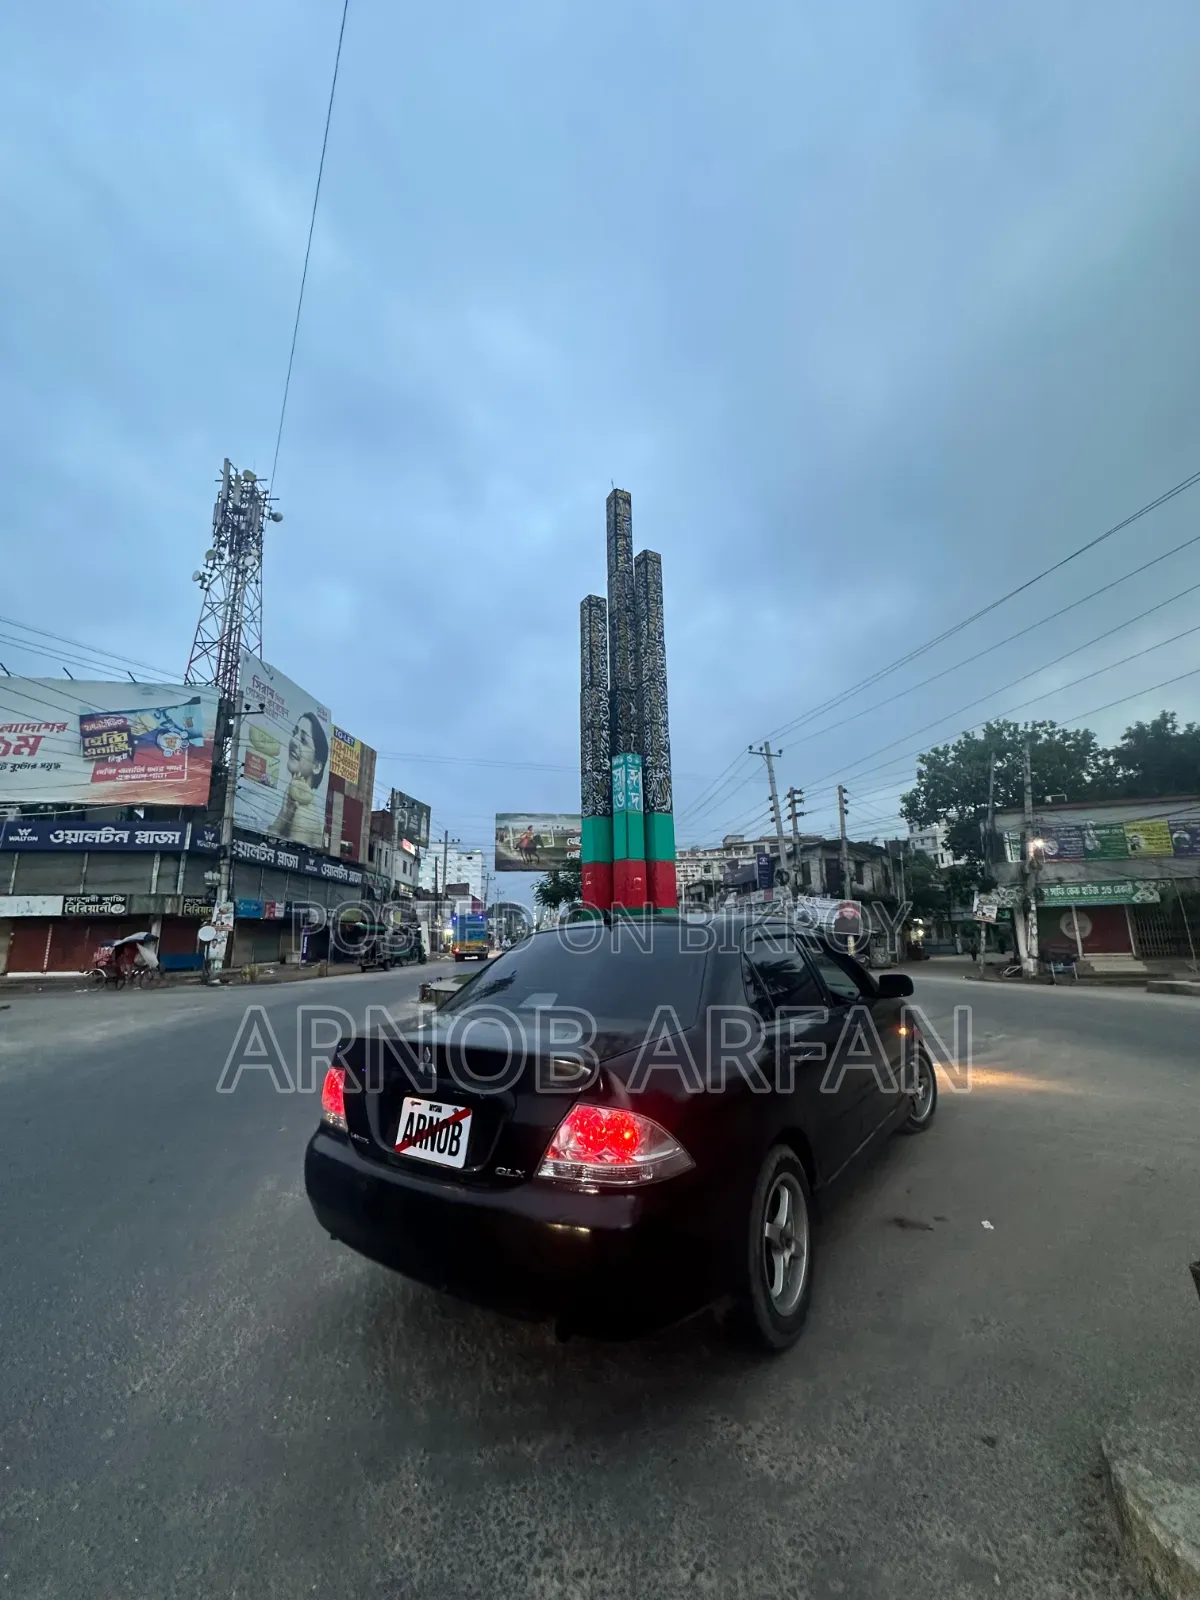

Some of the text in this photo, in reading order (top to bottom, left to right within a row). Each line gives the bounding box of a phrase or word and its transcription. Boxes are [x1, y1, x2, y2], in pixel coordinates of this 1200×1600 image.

[335, 728, 354, 745] TO-LET
[50, 826, 181, 844] ওয়ালটন প্লাজা
[277, 851, 299, 869] প্লাজা
[321, 863, 348, 880] ওয়ালটন
[64, 901, 112, 913] বিরিয়ানী
[184, 902, 214, 915] বিরিয়ান
[402, 1112, 463, 1157] ARNOB
[495, 1166, 526, 1179] GLX
